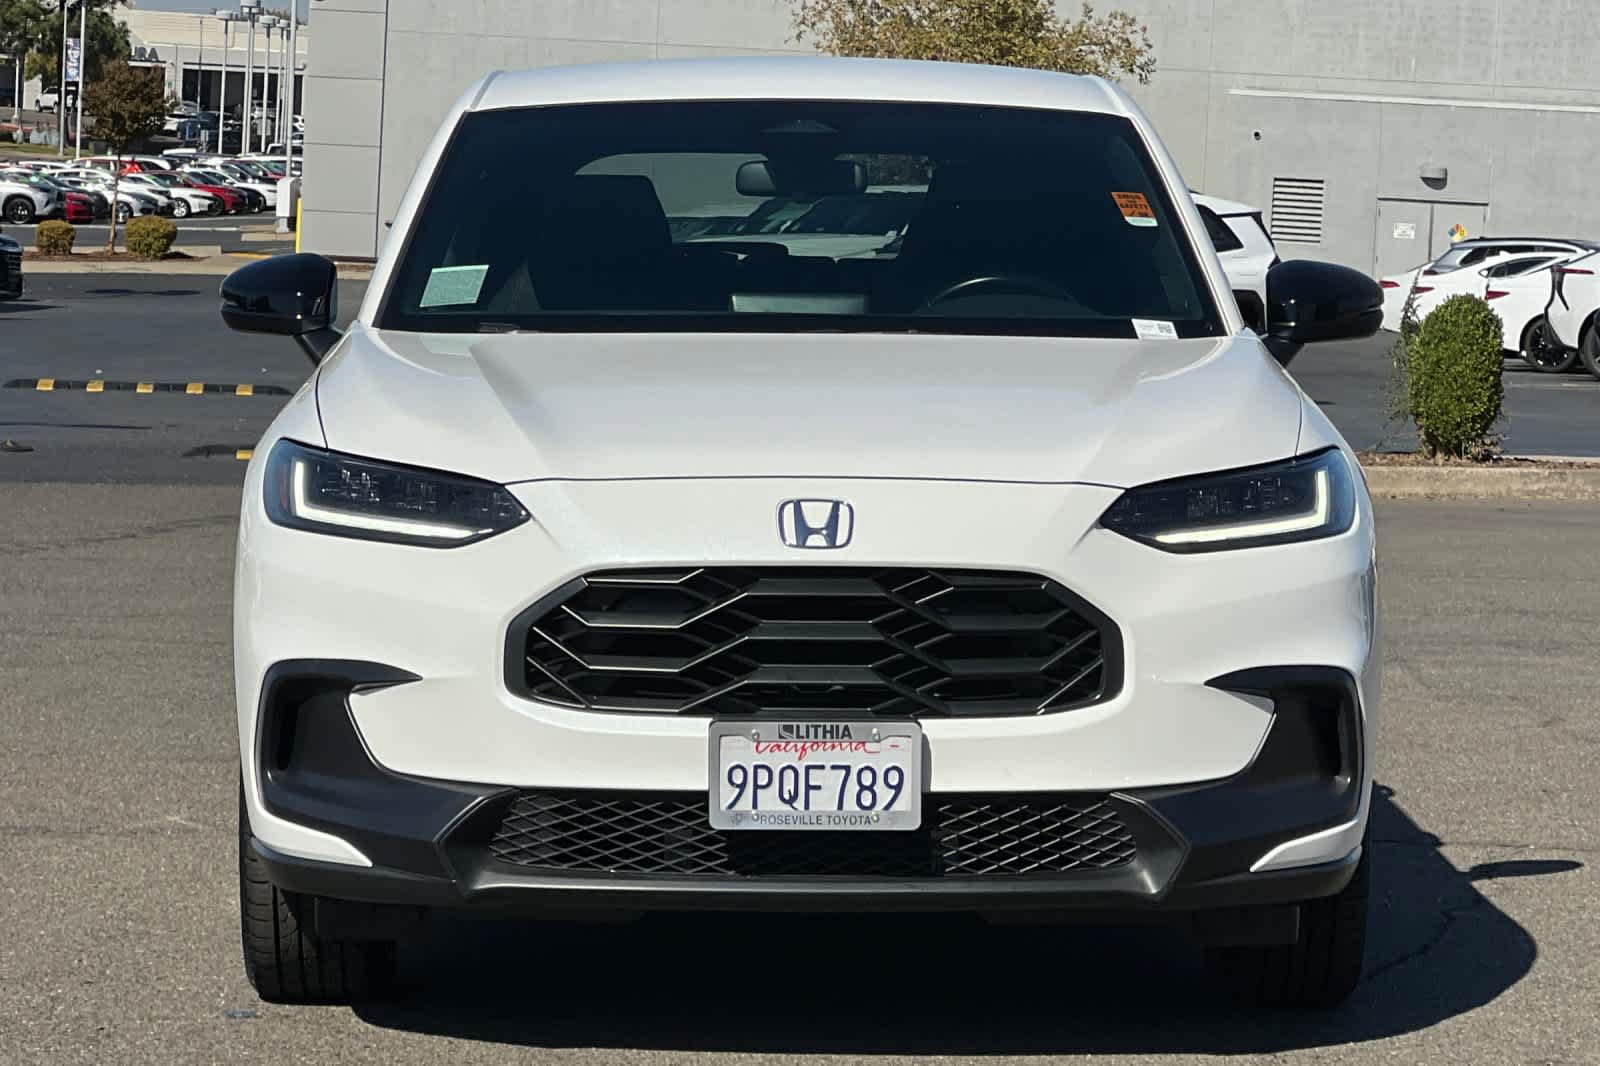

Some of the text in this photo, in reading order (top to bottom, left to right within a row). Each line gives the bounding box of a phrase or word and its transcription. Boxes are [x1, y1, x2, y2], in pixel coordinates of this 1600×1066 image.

[795, 724, 853, 739] LITHIA
[725, 763, 905, 811] 9PQF789
[760, 815, 871, 825] ROSEVILLE TOYOTA
